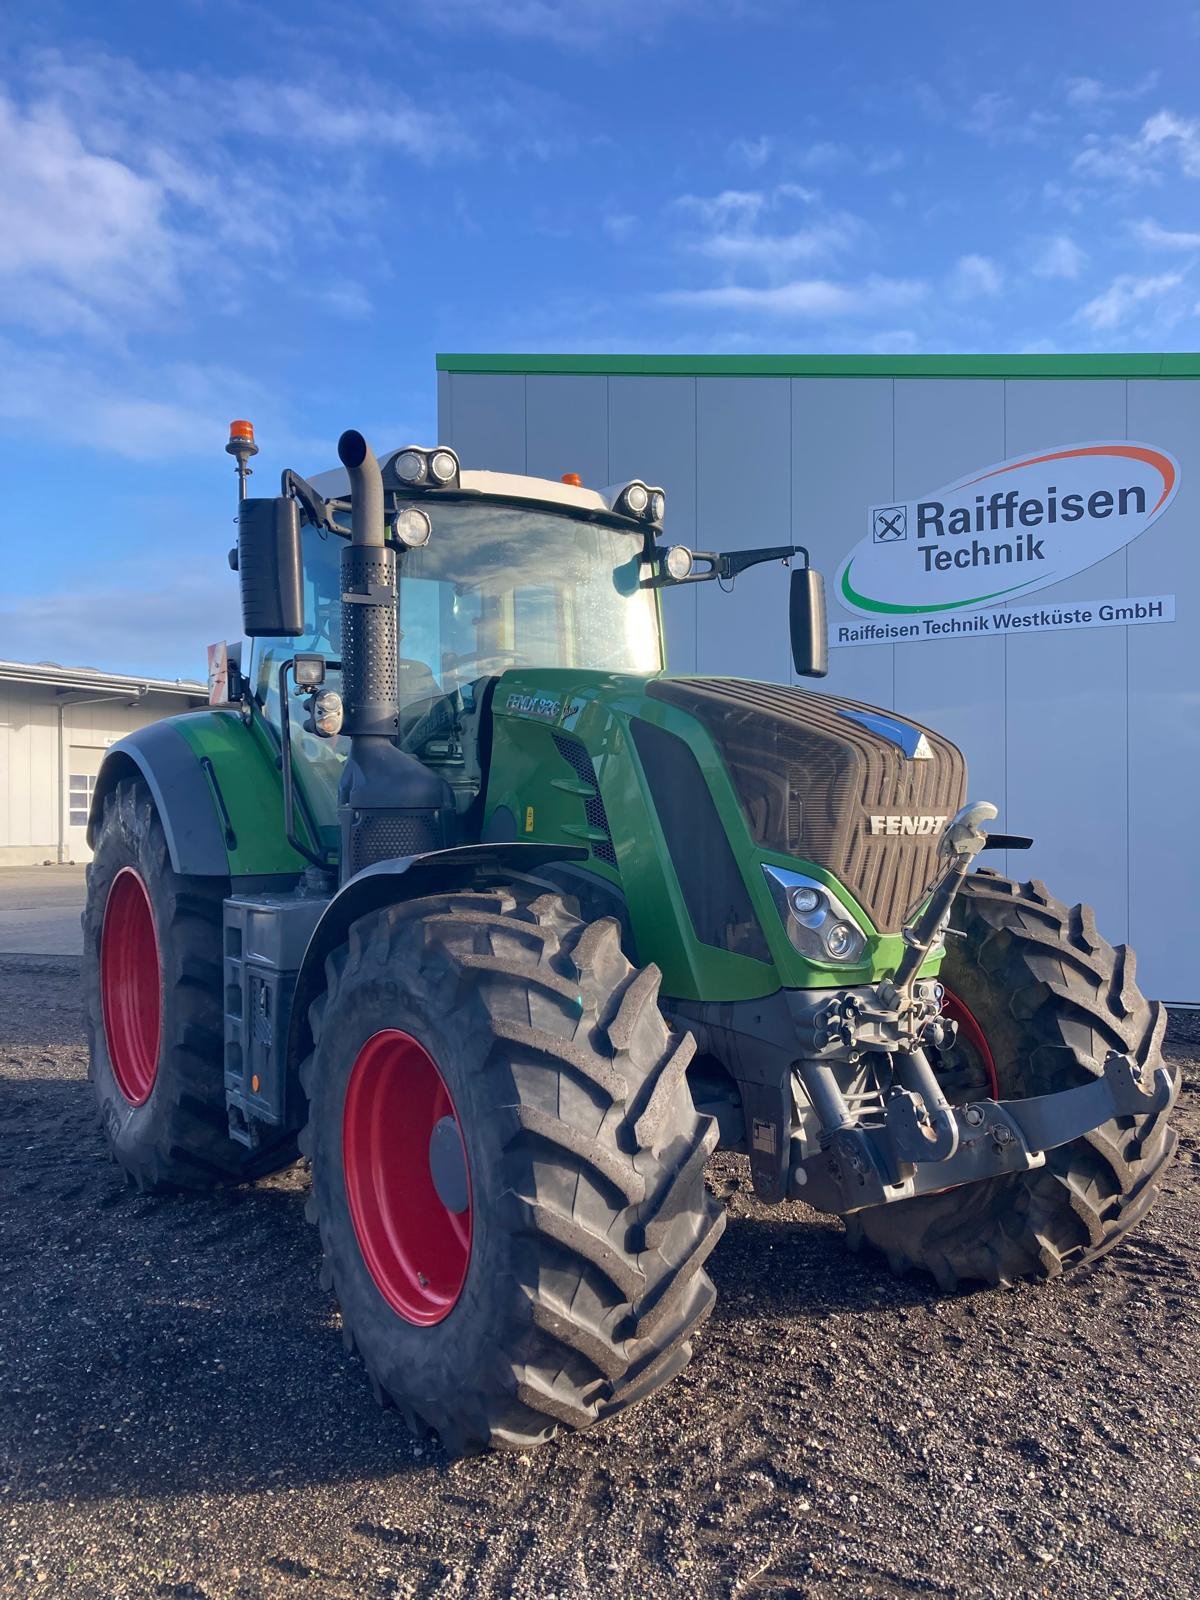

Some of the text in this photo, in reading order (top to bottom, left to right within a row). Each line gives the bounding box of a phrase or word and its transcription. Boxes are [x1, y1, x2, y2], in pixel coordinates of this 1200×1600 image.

[917, 486, 1146, 538] Raiffeisen
[918, 534, 1044, 571] Technik
[838, 601, 1163, 642] Raiffeisen Technik Westküste GmbH
[870, 815, 948, 835] FENDT
